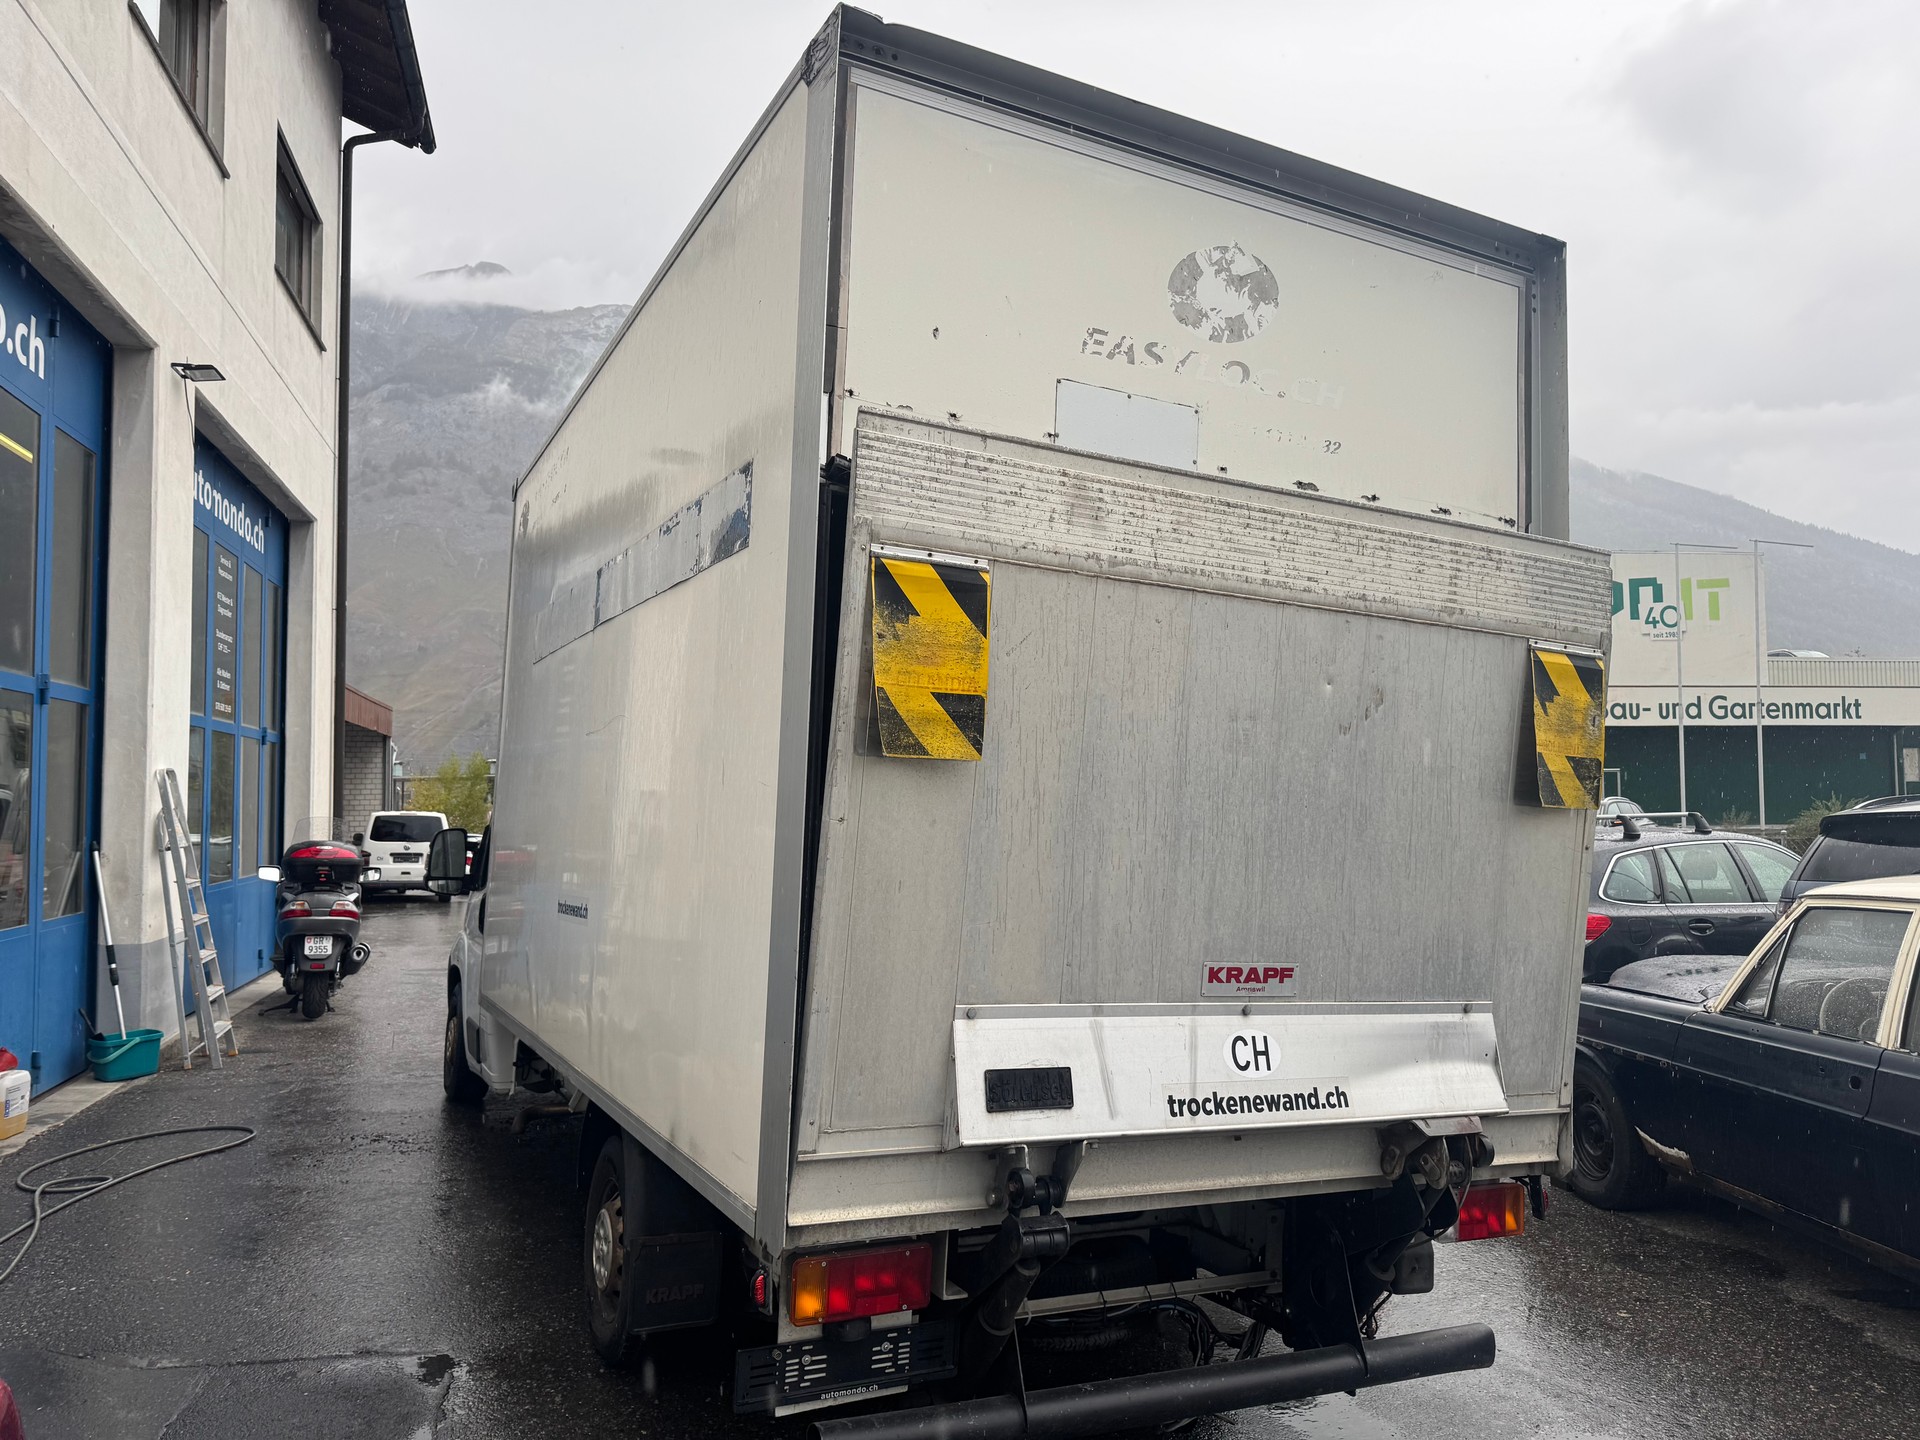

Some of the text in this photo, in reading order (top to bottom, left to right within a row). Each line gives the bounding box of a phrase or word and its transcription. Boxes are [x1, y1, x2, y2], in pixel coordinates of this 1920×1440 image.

[1322, 439, 1342, 454] 32
[1644, 604, 1681, 629] 40
[1708, 695, 1862, 720] Gartenmarkt
[308, 945, 328, 954] 9355
[313, 936, 324, 945] GR
[1207, 966, 1295, 984] KRAPF
[1231, 1034, 1271, 1072] CH
[1166, 1086, 1349, 1118] trockenewand.ch
[646, 1283, 705, 1305] KRAPF
[820, 1384, 879, 1400] automondo.ch
